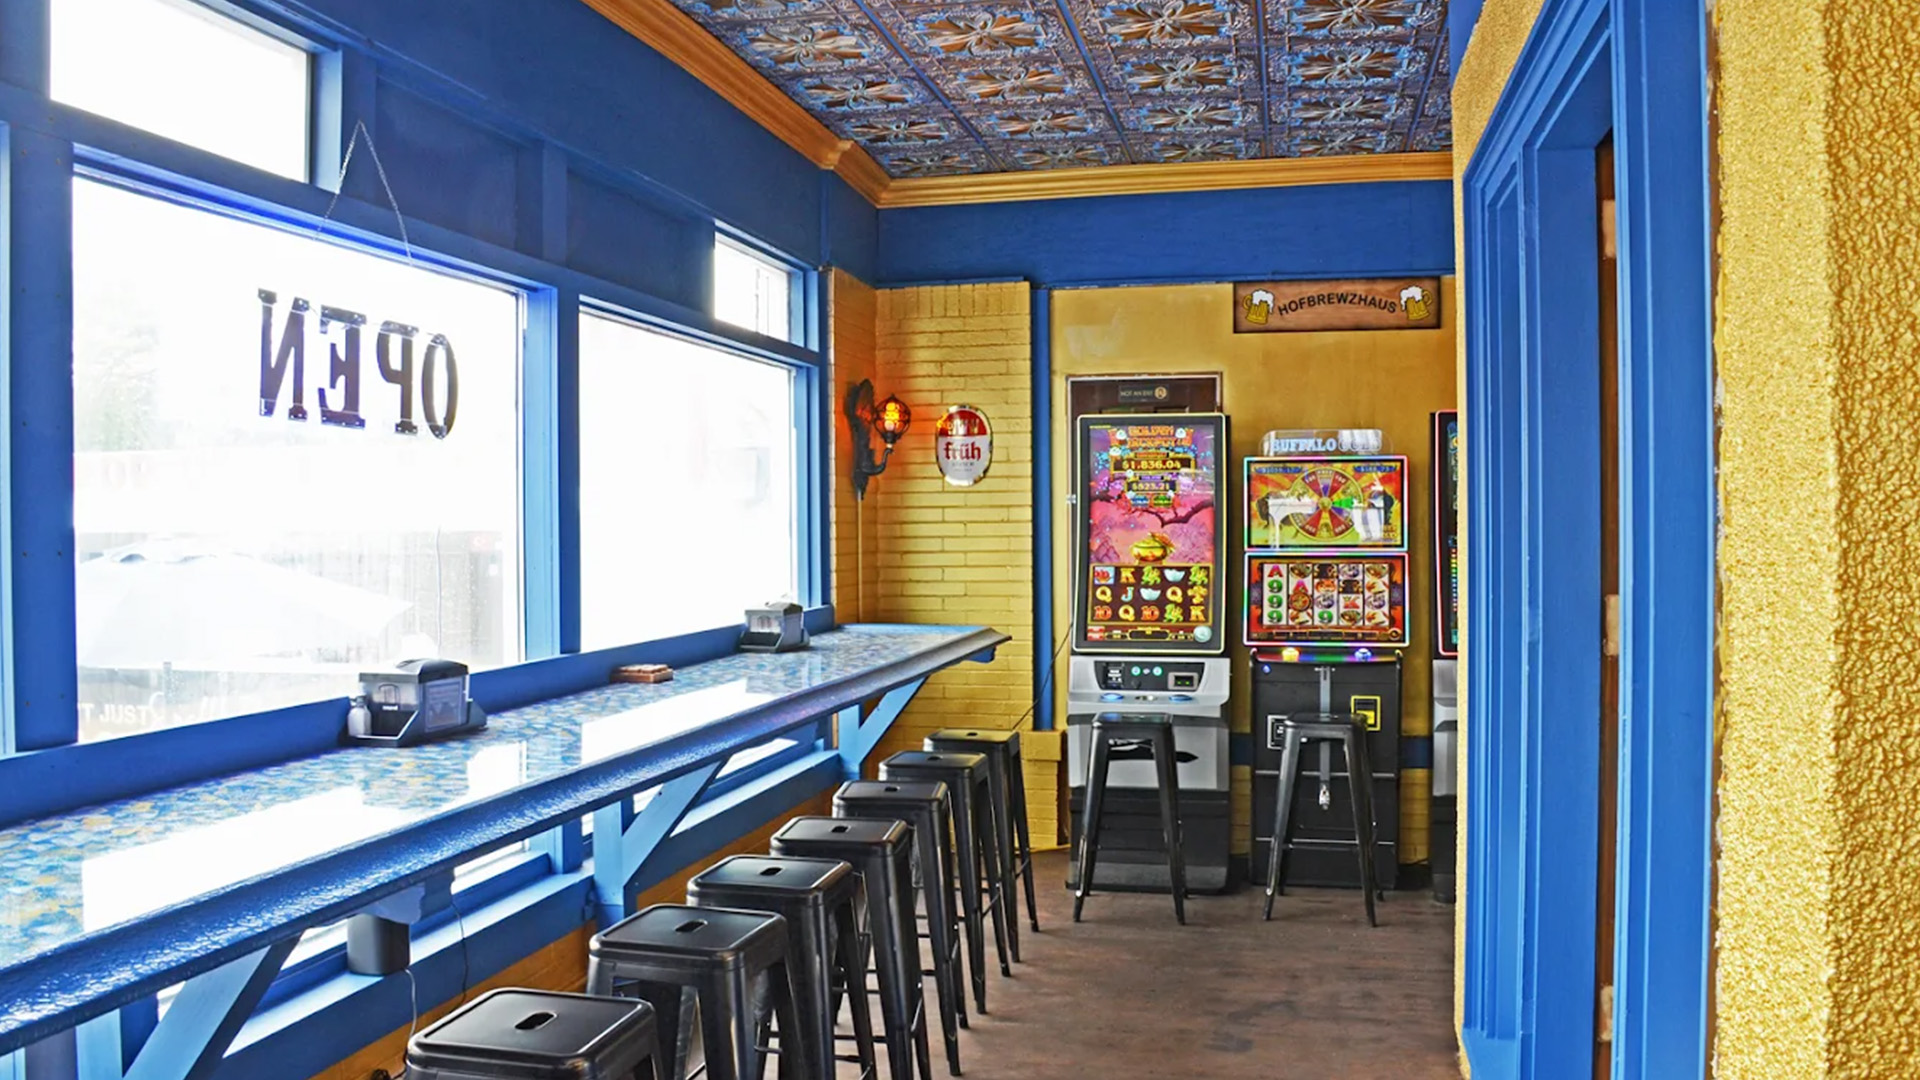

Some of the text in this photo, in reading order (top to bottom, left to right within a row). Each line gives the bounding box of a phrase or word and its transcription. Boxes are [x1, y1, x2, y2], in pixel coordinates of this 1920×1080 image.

[1278, 292, 1397, 316] HOFBREWZHAUS
[943, 441, 982, 461] früh
[1271, 437, 1338, 452] BUFFALO
[99, 702, 151, 726] JUST
